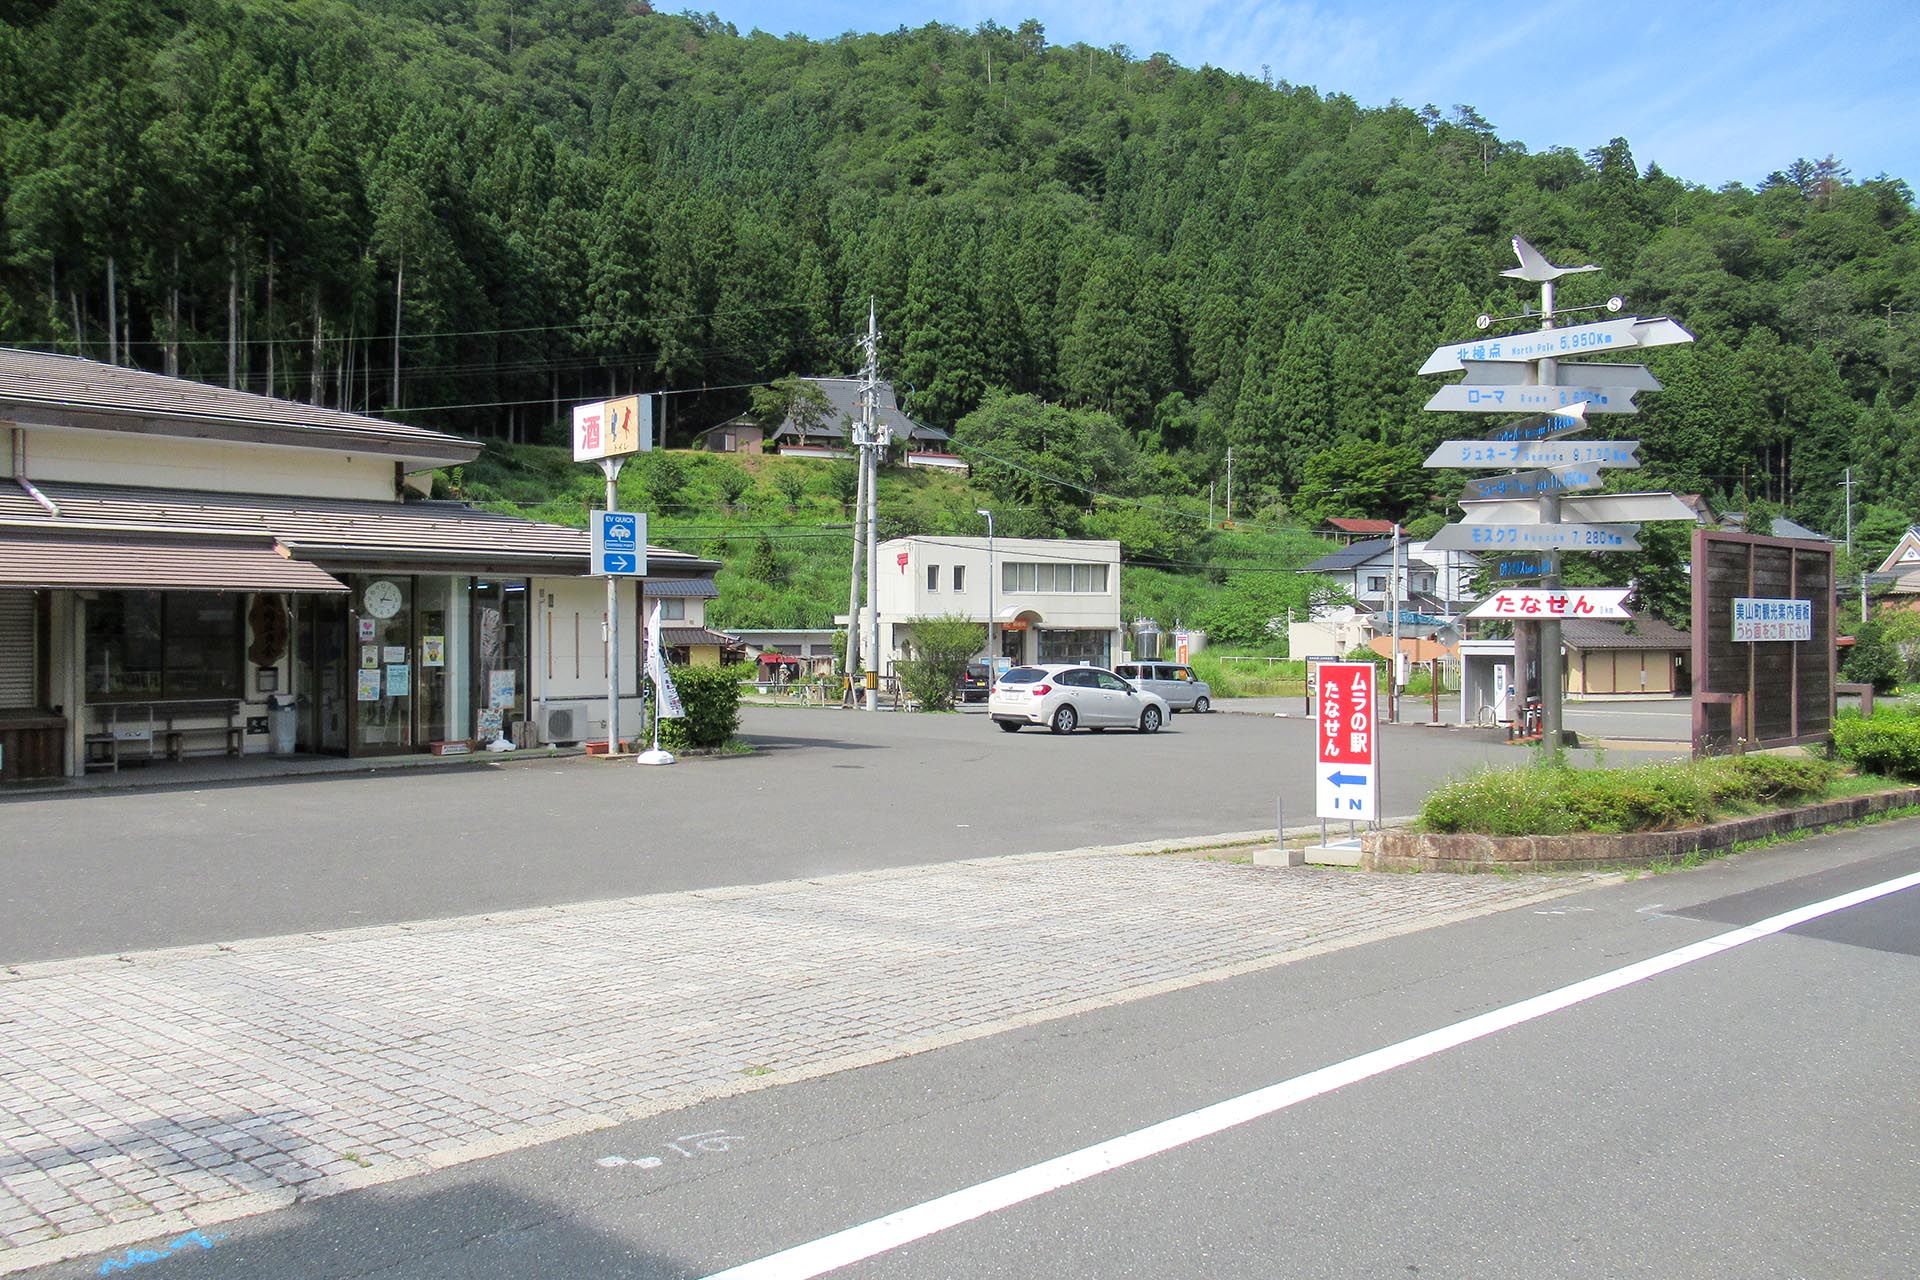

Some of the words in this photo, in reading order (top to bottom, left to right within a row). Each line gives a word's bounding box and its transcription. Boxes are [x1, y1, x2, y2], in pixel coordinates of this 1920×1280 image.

[1456, 342, 1502, 361] 北極点
[1511, 344, 1534, 356] North
[1536, 342, 1555, 354] Pole
[1467, 388, 1506, 405] ローマ
[582, 415, 601, 450] 酒
[605, 515, 615, 523] EV
[615, 516, 635, 524] QUICK
[1471, 527, 1518, 544] モスクワ
[1495, 595, 1595, 614] たなせん
[1736, 603, 1810, 620] 美山町観光案内看板
[1323, 680, 1341, 757] たなせん
[1350, 671, 1368, 754] ムラの駅
[1334, 797, 1363, 811] IN
